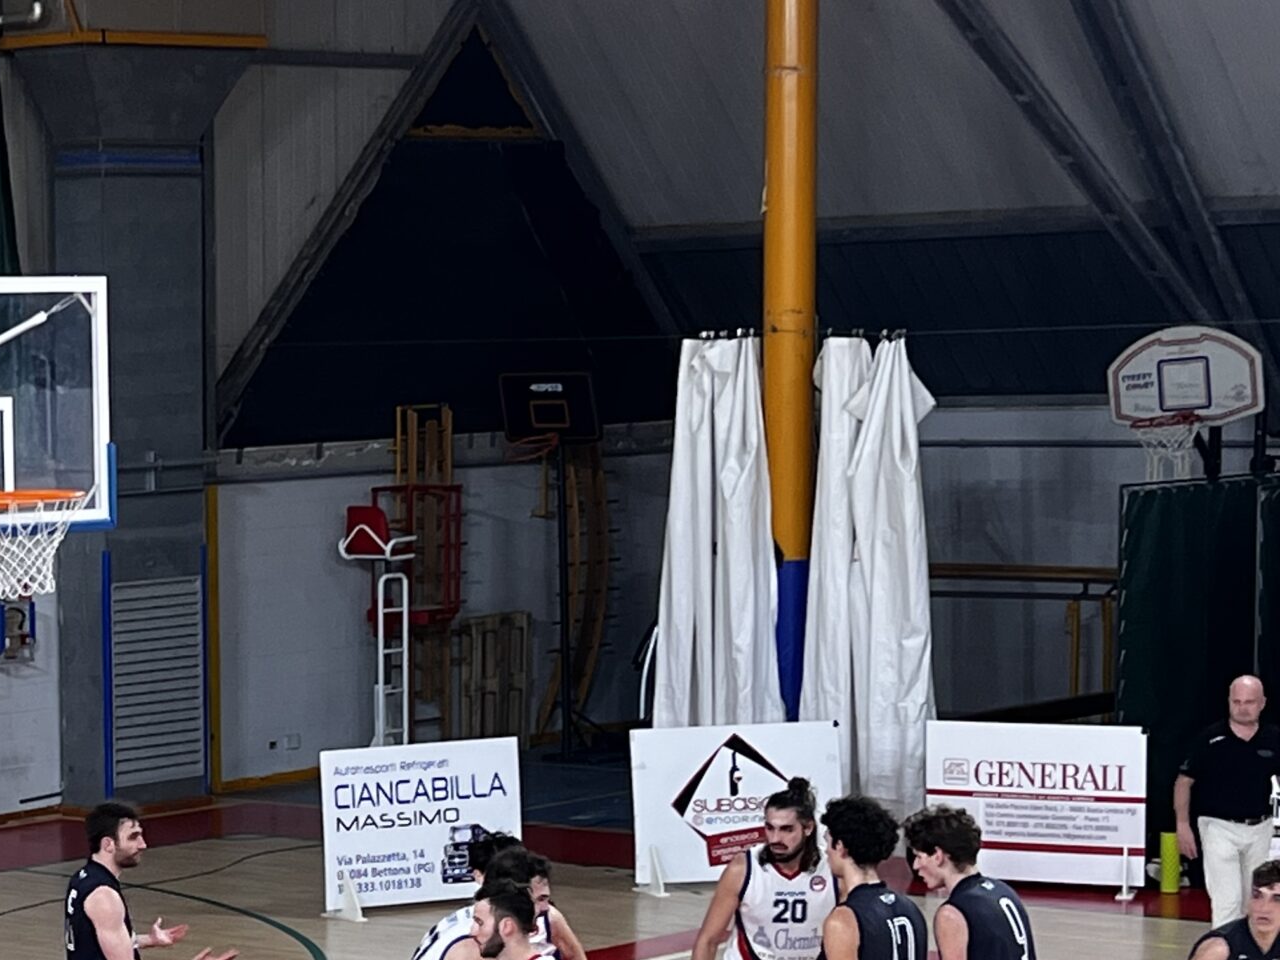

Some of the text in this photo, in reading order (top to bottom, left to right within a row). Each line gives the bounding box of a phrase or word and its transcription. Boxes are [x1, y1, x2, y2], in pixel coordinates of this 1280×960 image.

[974, 760, 1126, 792] GENERALI
[334, 772, 507, 809] CIANCABILLA
[336, 808, 460, 832] MASSIMO
[336, 849, 425, 866] Via Palazzetta, 14
[337, 862, 436, 881] 0084 Bettona (PG)
[772, 899, 807, 923] 20
